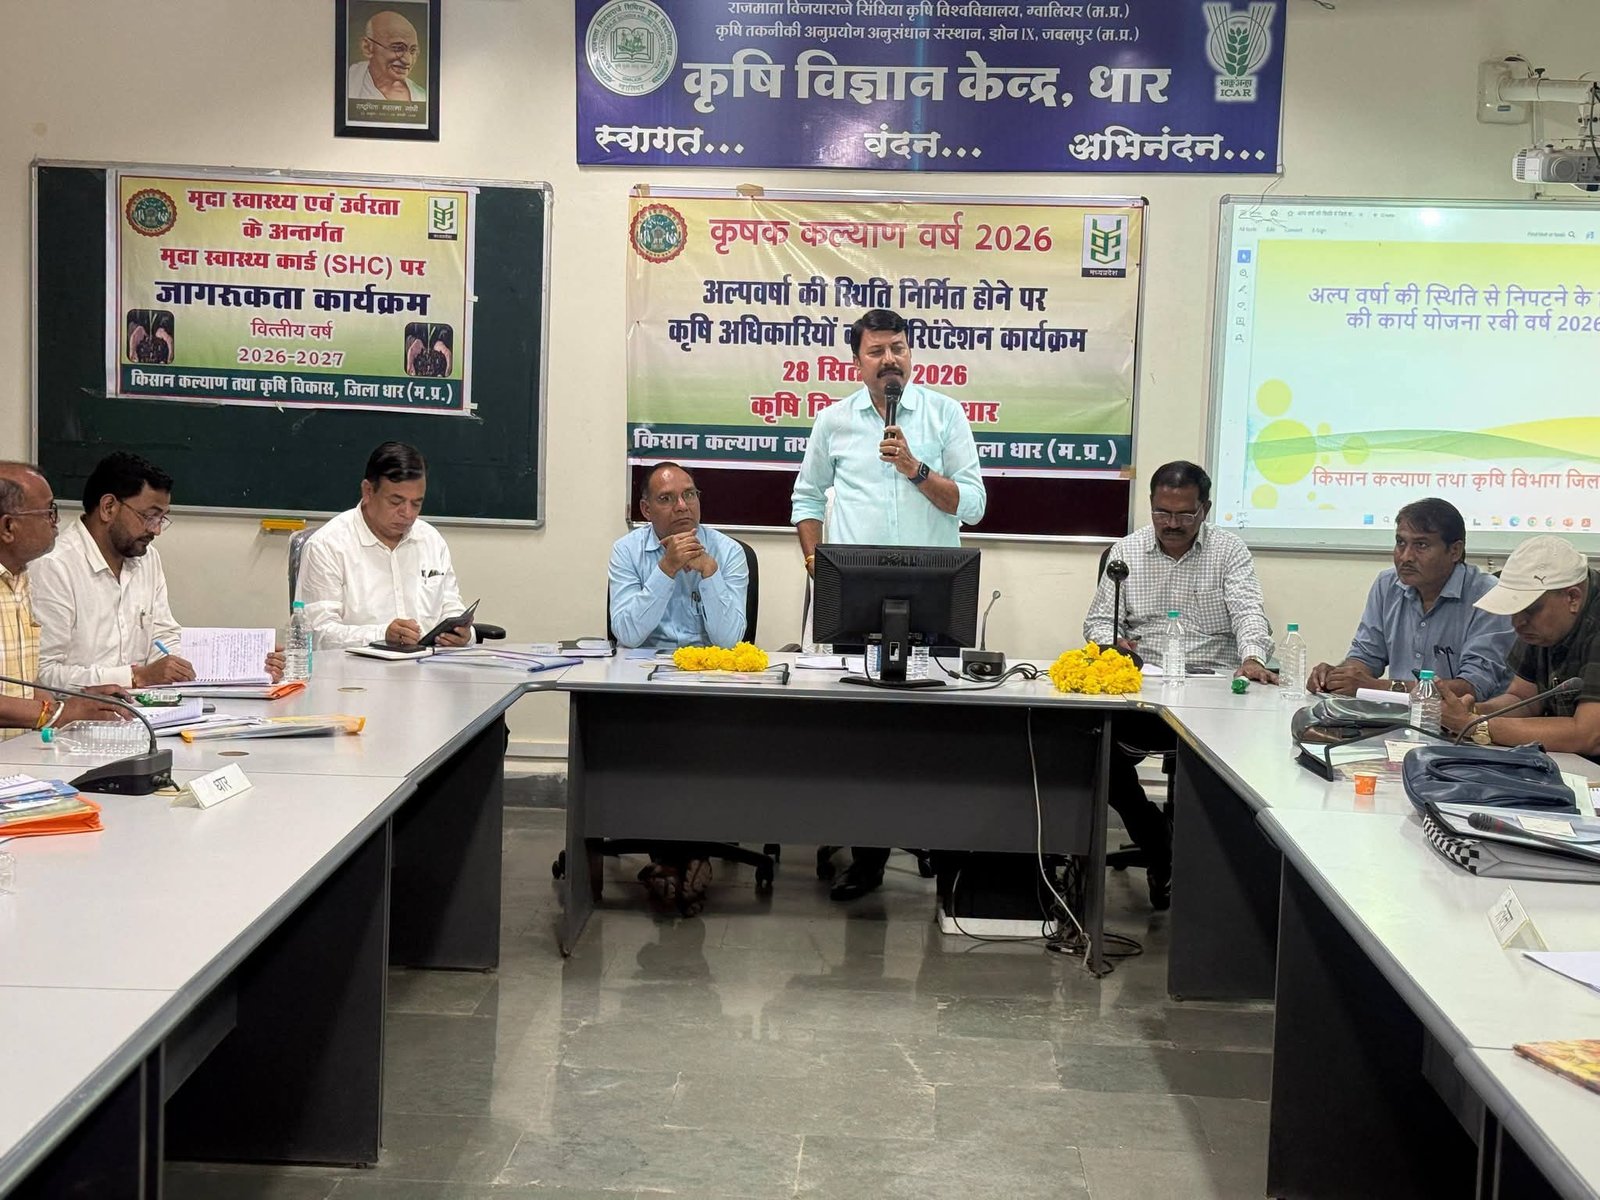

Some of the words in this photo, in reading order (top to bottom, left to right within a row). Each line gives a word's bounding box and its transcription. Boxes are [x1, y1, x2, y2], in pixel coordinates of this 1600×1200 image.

[728, 1, 783, 14] राजमाता
[856, 0, 902, 16] सिंधिया
[907, 0, 933, 21] कृषि
[936, 1, 1023, 18] विश्वविद्यालय,
[1027, 1, 1083, 18] ग्वालियर
[1086, 3, 1130, 19] (म.प्र.)
[716, 20, 742, 41] कृषि
[746, 20, 801, 38] तकनीकी
[804, 24, 864, 43] अनुप्रयोग
[867, 24, 930, 44] अनुसंधान
[933, 24, 986, 42] संस्थान,
[989, 24, 1018, 41] झोन
[1042, 28, 1093, 46] जबलपुर
[1096, 26, 1140, 43] (म.प्र.)
[682, 48, 785, 114] कृषि
[795, 49, 949, 104] विज्ञान
[957, 50, 1074, 108] केन्द्र,
[1089, 65, 1172, 103] धार
[1220, 89, 1252, 97] ICAR
[594, 125, 744, 156] स्वागत...
[1068, 125, 1266, 163] अभिनंदन...
[187, 190, 225, 212] मृदा
[232, 192, 297, 211] स्वास्थ्य
[304, 193, 332, 213] एवं
[340, 194, 400, 216] उर्वरता
[242, 218, 262, 239] के
[269, 222, 344, 243] अन्तर्गत
[708, 218, 790, 255] कृषक
[800, 221, 909, 249] कल्याण
[918, 211, 963, 250] वर्ष
[975, 224, 1052, 251] 2026
[160, 248, 197, 270] मृदा
[204, 250, 271, 269] स्वास्थ्य
[276, 250, 317, 271] कार्ड
[323, 253, 393, 280] (SHC)
[400, 260, 427, 276] पर
[155, 281, 305, 310] जागरूकता
[313, 283, 431, 316] कार्यक्रम
[703, 274, 792, 305] अल्पवर्षा
[798, 276, 829, 307] की
[834, 276, 894, 308] स्थिति
[899, 278, 967, 309] निर्मित
[973, 279, 1013, 311] होने
[1020, 287, 1048, 311] पर
[1309, 287, 1350, 306] अल्प
[1356, 282, 1391, 306] वर्षा
[1395, 283, 1420, 306] की
[1426, 283, 1478, 307] स्थिति
[1483, 285, 1500, 307] से
[1506, 284, 1568, 307] निपटने
[1573, 285, 1594, 307] के
[250, 322, 305, 339] वित्तीय
[308, 322, 333, 340] वर्ष
[668, 313, 714, 352] कृषि
[718, 314, 839, 347] अधिकारियों
[907, 318, 994, 350] रिएंटेशन
[1000, 320, 1088, 352] कार्यक्रम
[1346, 307, 1371, 329] की
[1378, 307, 1419, 331] कार्य
[1424, 310, 1481, 332] योजना
[1487, 309, 1518, 332] रबी
[1524, 309, 1552, 332] वर्ष
[1557, 316, 1600, 332] 2026
[238, 348, 344, 366] 2026-2027
[783, 361, 809, 382] 28
[913, 364, 968, 385] 2026
[130, 370, 175, 388] किसान
[178, 375, 228, 391] कल्याण
[231, 376, 256, 392] तथा
[259, 375, 287, 396] कृषि
[290, 377, 340, 397] विकास,
[344, 379, 379, 398] जिला
[382, 383, 404, 398] धार
[407, 381, 453, 405] (म.प्र.)
[751, 392, 801, 423] कृषि
[633, 429, 699, 450] किसान
[704, 435, 778, 452] कल्याण
[783, 436, 810, 452] तथ
[1010, 442, 1043, 459] धार
[1047, 438, 1117, 464] (म.प्र.)
[1312, 466, 1367, 488] किसान
[1372, 472, 1432, 488] कल्याण
[1436, 472, 1466, 488] तथा
[1472, 468, 1506, 492] कृषि
[1511, 468, 1562, 488] विभाग
[1566, 469, 1600, 490] जिल
